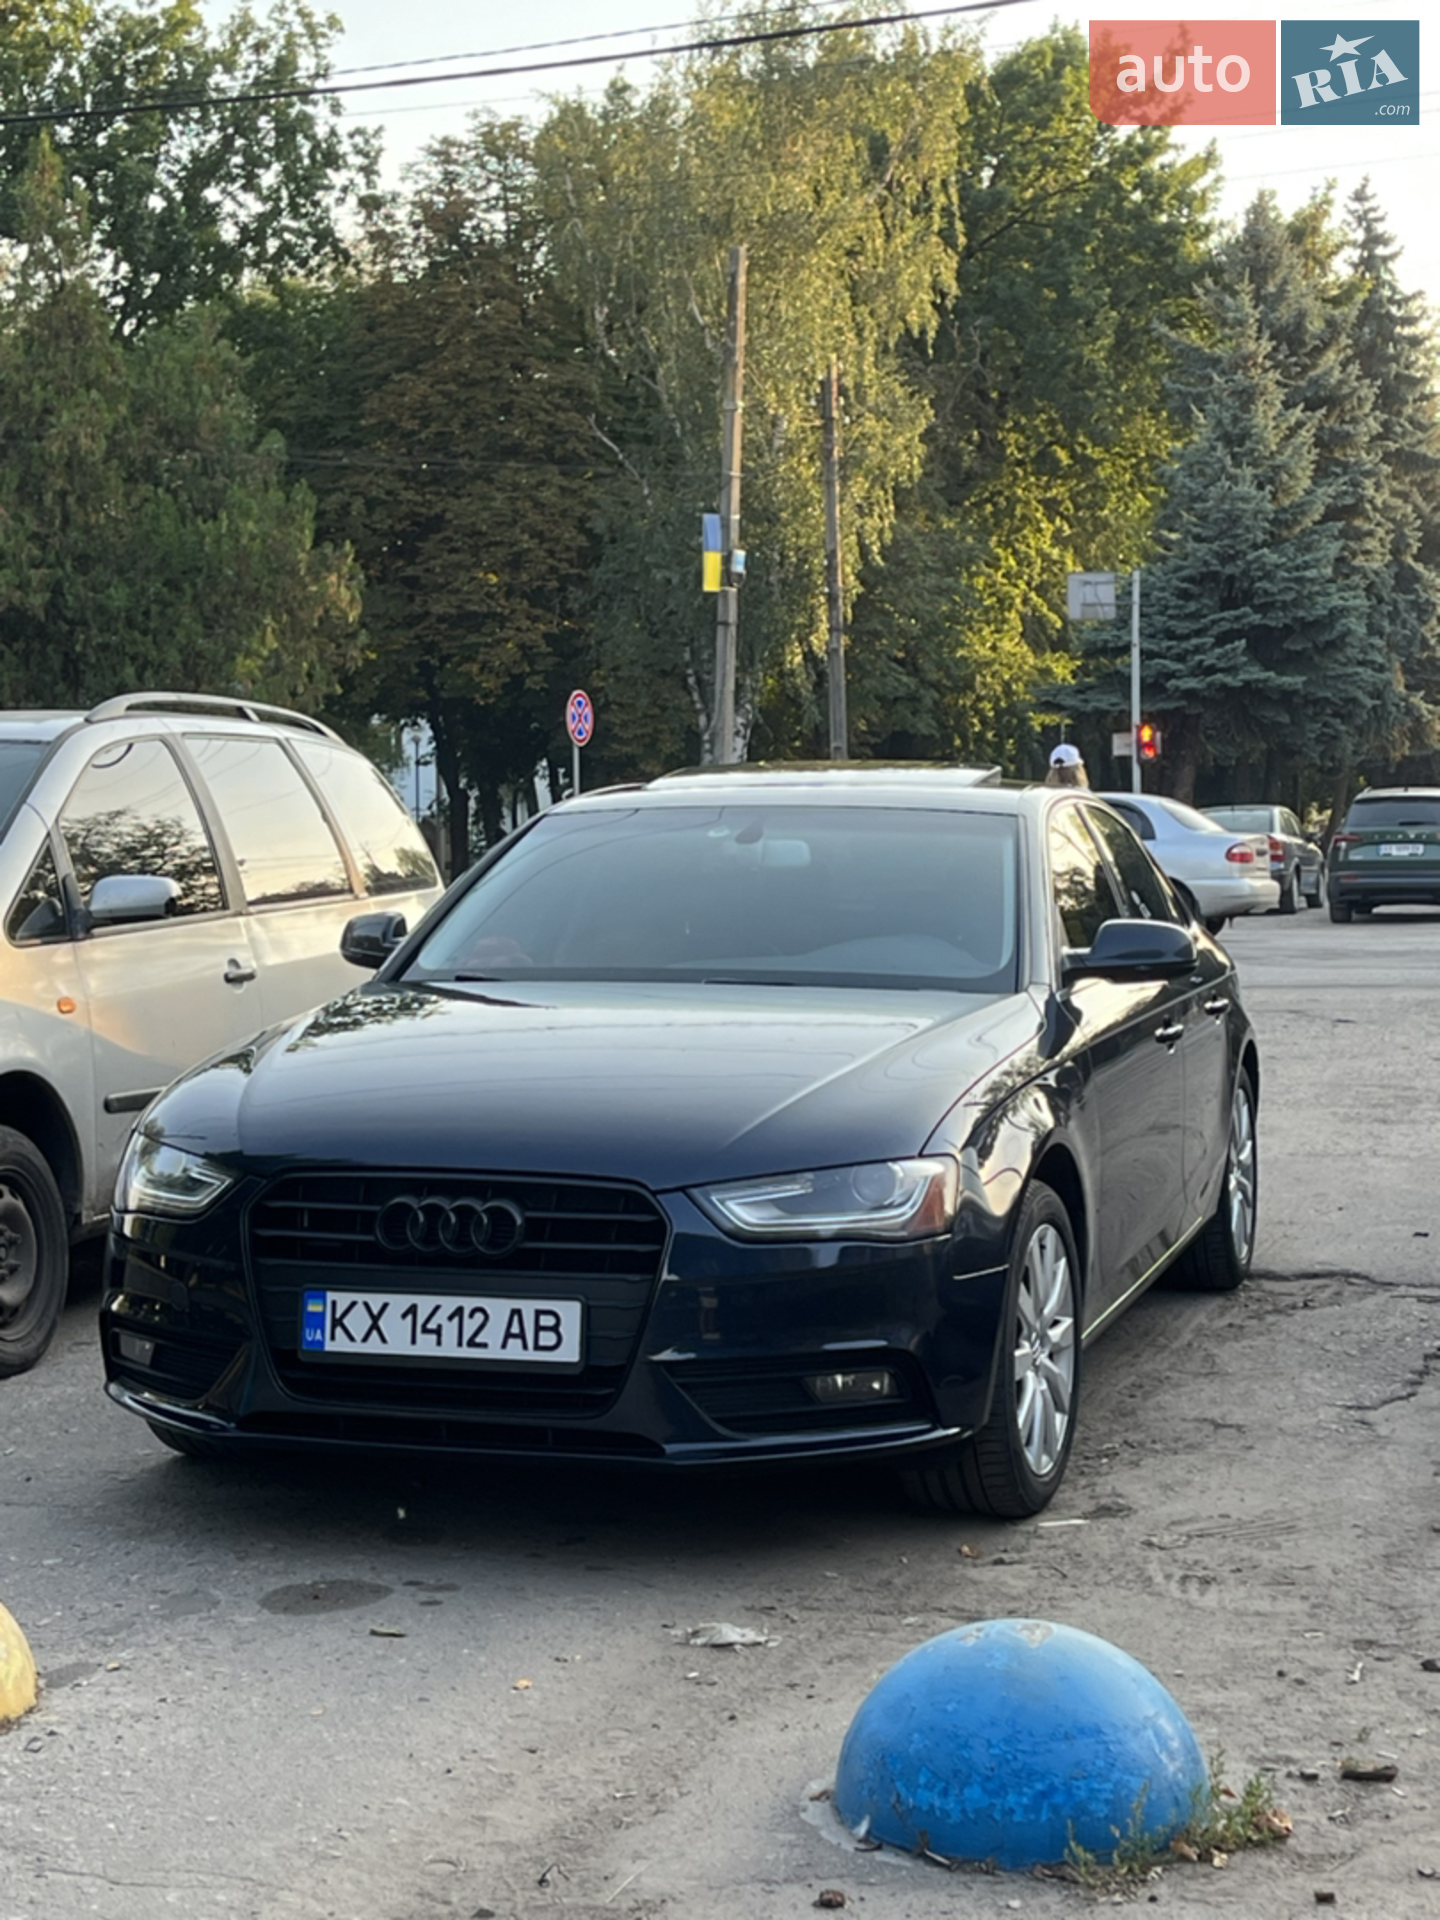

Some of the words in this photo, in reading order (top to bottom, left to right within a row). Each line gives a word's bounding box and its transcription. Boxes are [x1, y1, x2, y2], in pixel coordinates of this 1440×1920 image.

[305, 1328, 323, 1341] UA
[329, 1299, 390, 1344] KX
[400, 1303, 490, 1349] 1412
[500, 1308, 563, 1352] AB
